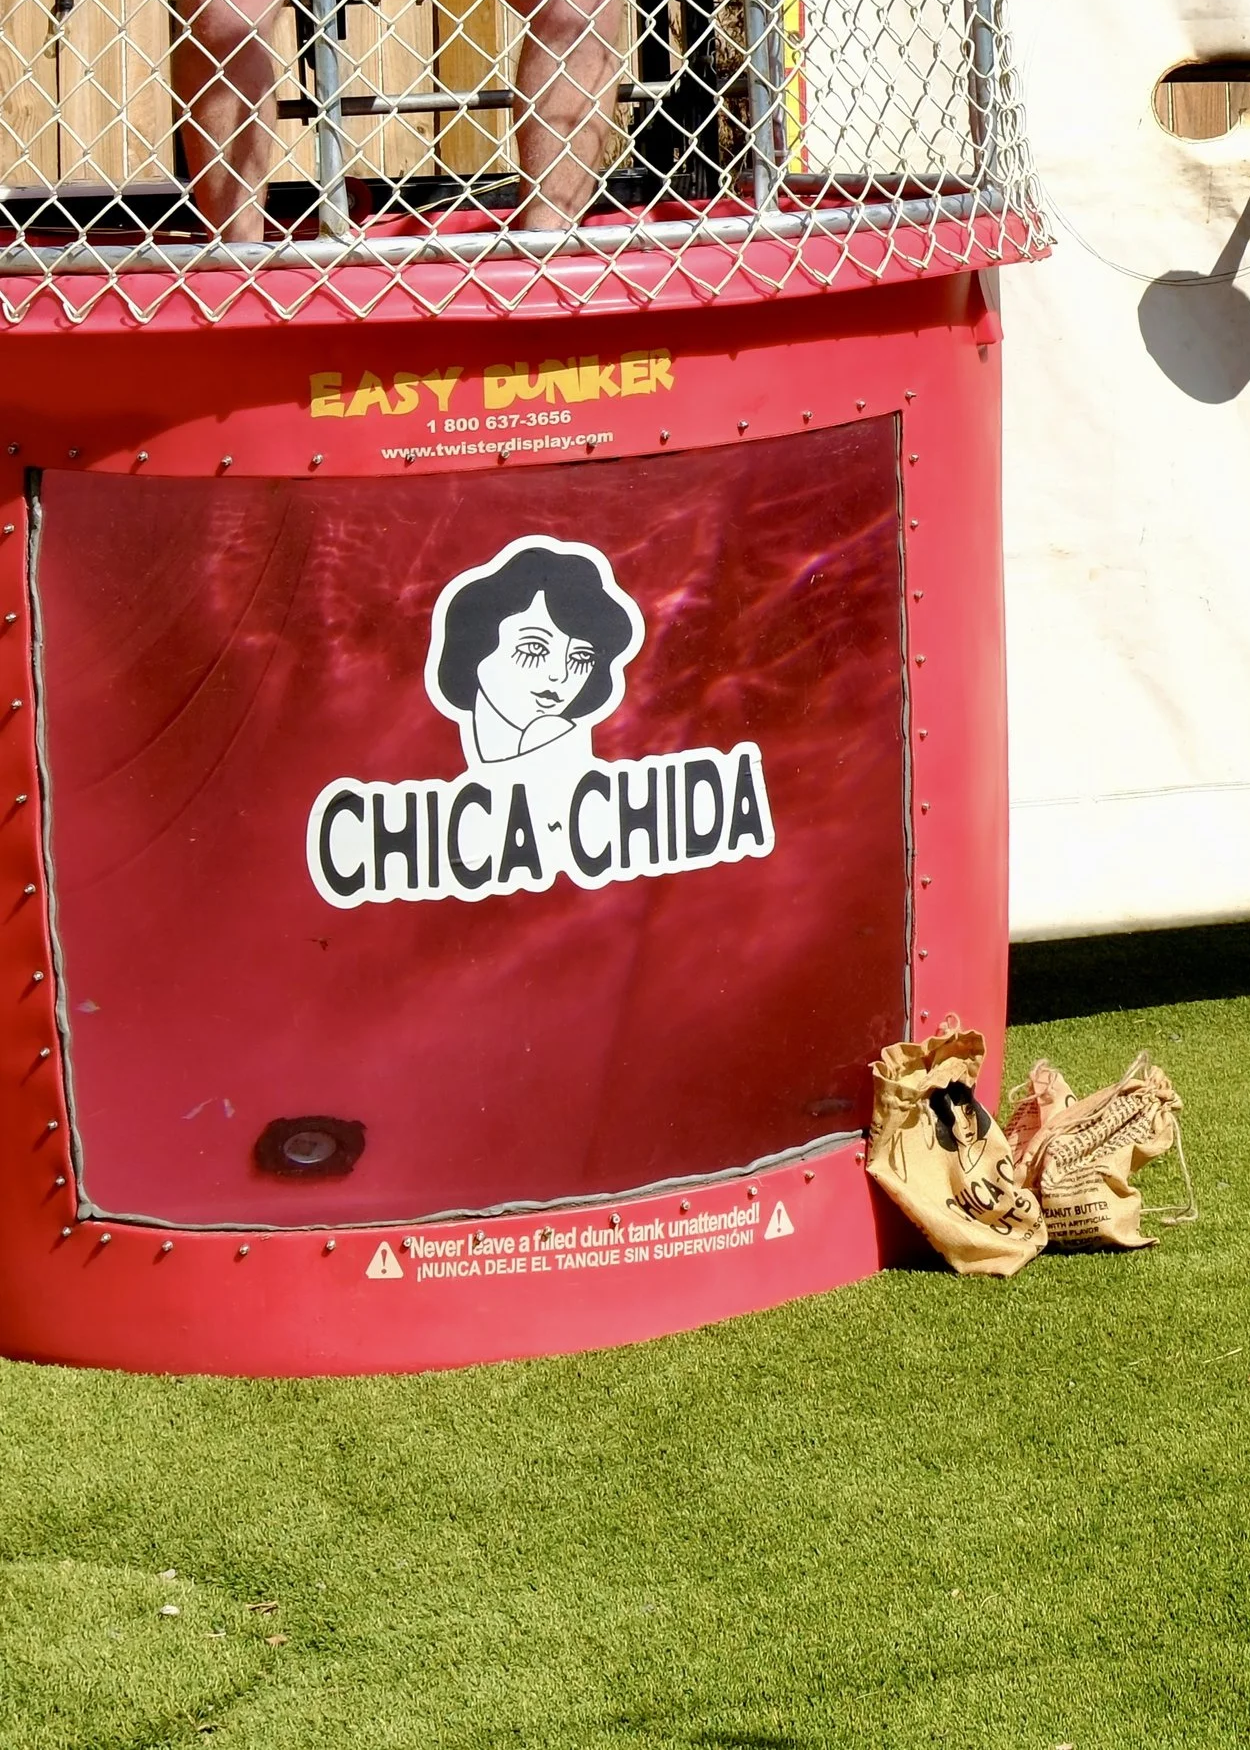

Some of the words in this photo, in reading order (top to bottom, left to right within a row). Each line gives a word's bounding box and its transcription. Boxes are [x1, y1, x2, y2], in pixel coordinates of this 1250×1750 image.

[308, 366, 464, 418] EASY
[483, 348, 675, 410] DUNKER
[426, 420, 437, 434] 1
[444, 417, 480, 433] 800
[485, 410, 572, 431] 637-3656
[381, 430, 614, 459] www.twisterdisplay.com
[1075, 1201, 1109, 1215] BUTTER
[410, 1236, 465, 1259] Never
[468, 1233, 515, 1256] leave
[519, 1235, 529, 1253] a
[533, 1226, 576, 1252] filled
[580, 1224, 625, 1248] dunk
[628, 1218, 665, 1242] tank
[668, 1201, 761, 1238] unattended!
[1069, 1215, 1112, 1228] ARTIFICIAL
[1069, 1226, 1100, 1236] FLAVOR
[416, 1259, 481, 1282] ¡NUNCA
[484, 1257, 527, 1276] DEJE
[531, 1256, 552, 1272] EL
[555, 1250, 620, 1271] TANQUE
[624, 1246, 650, 1264] SIN
